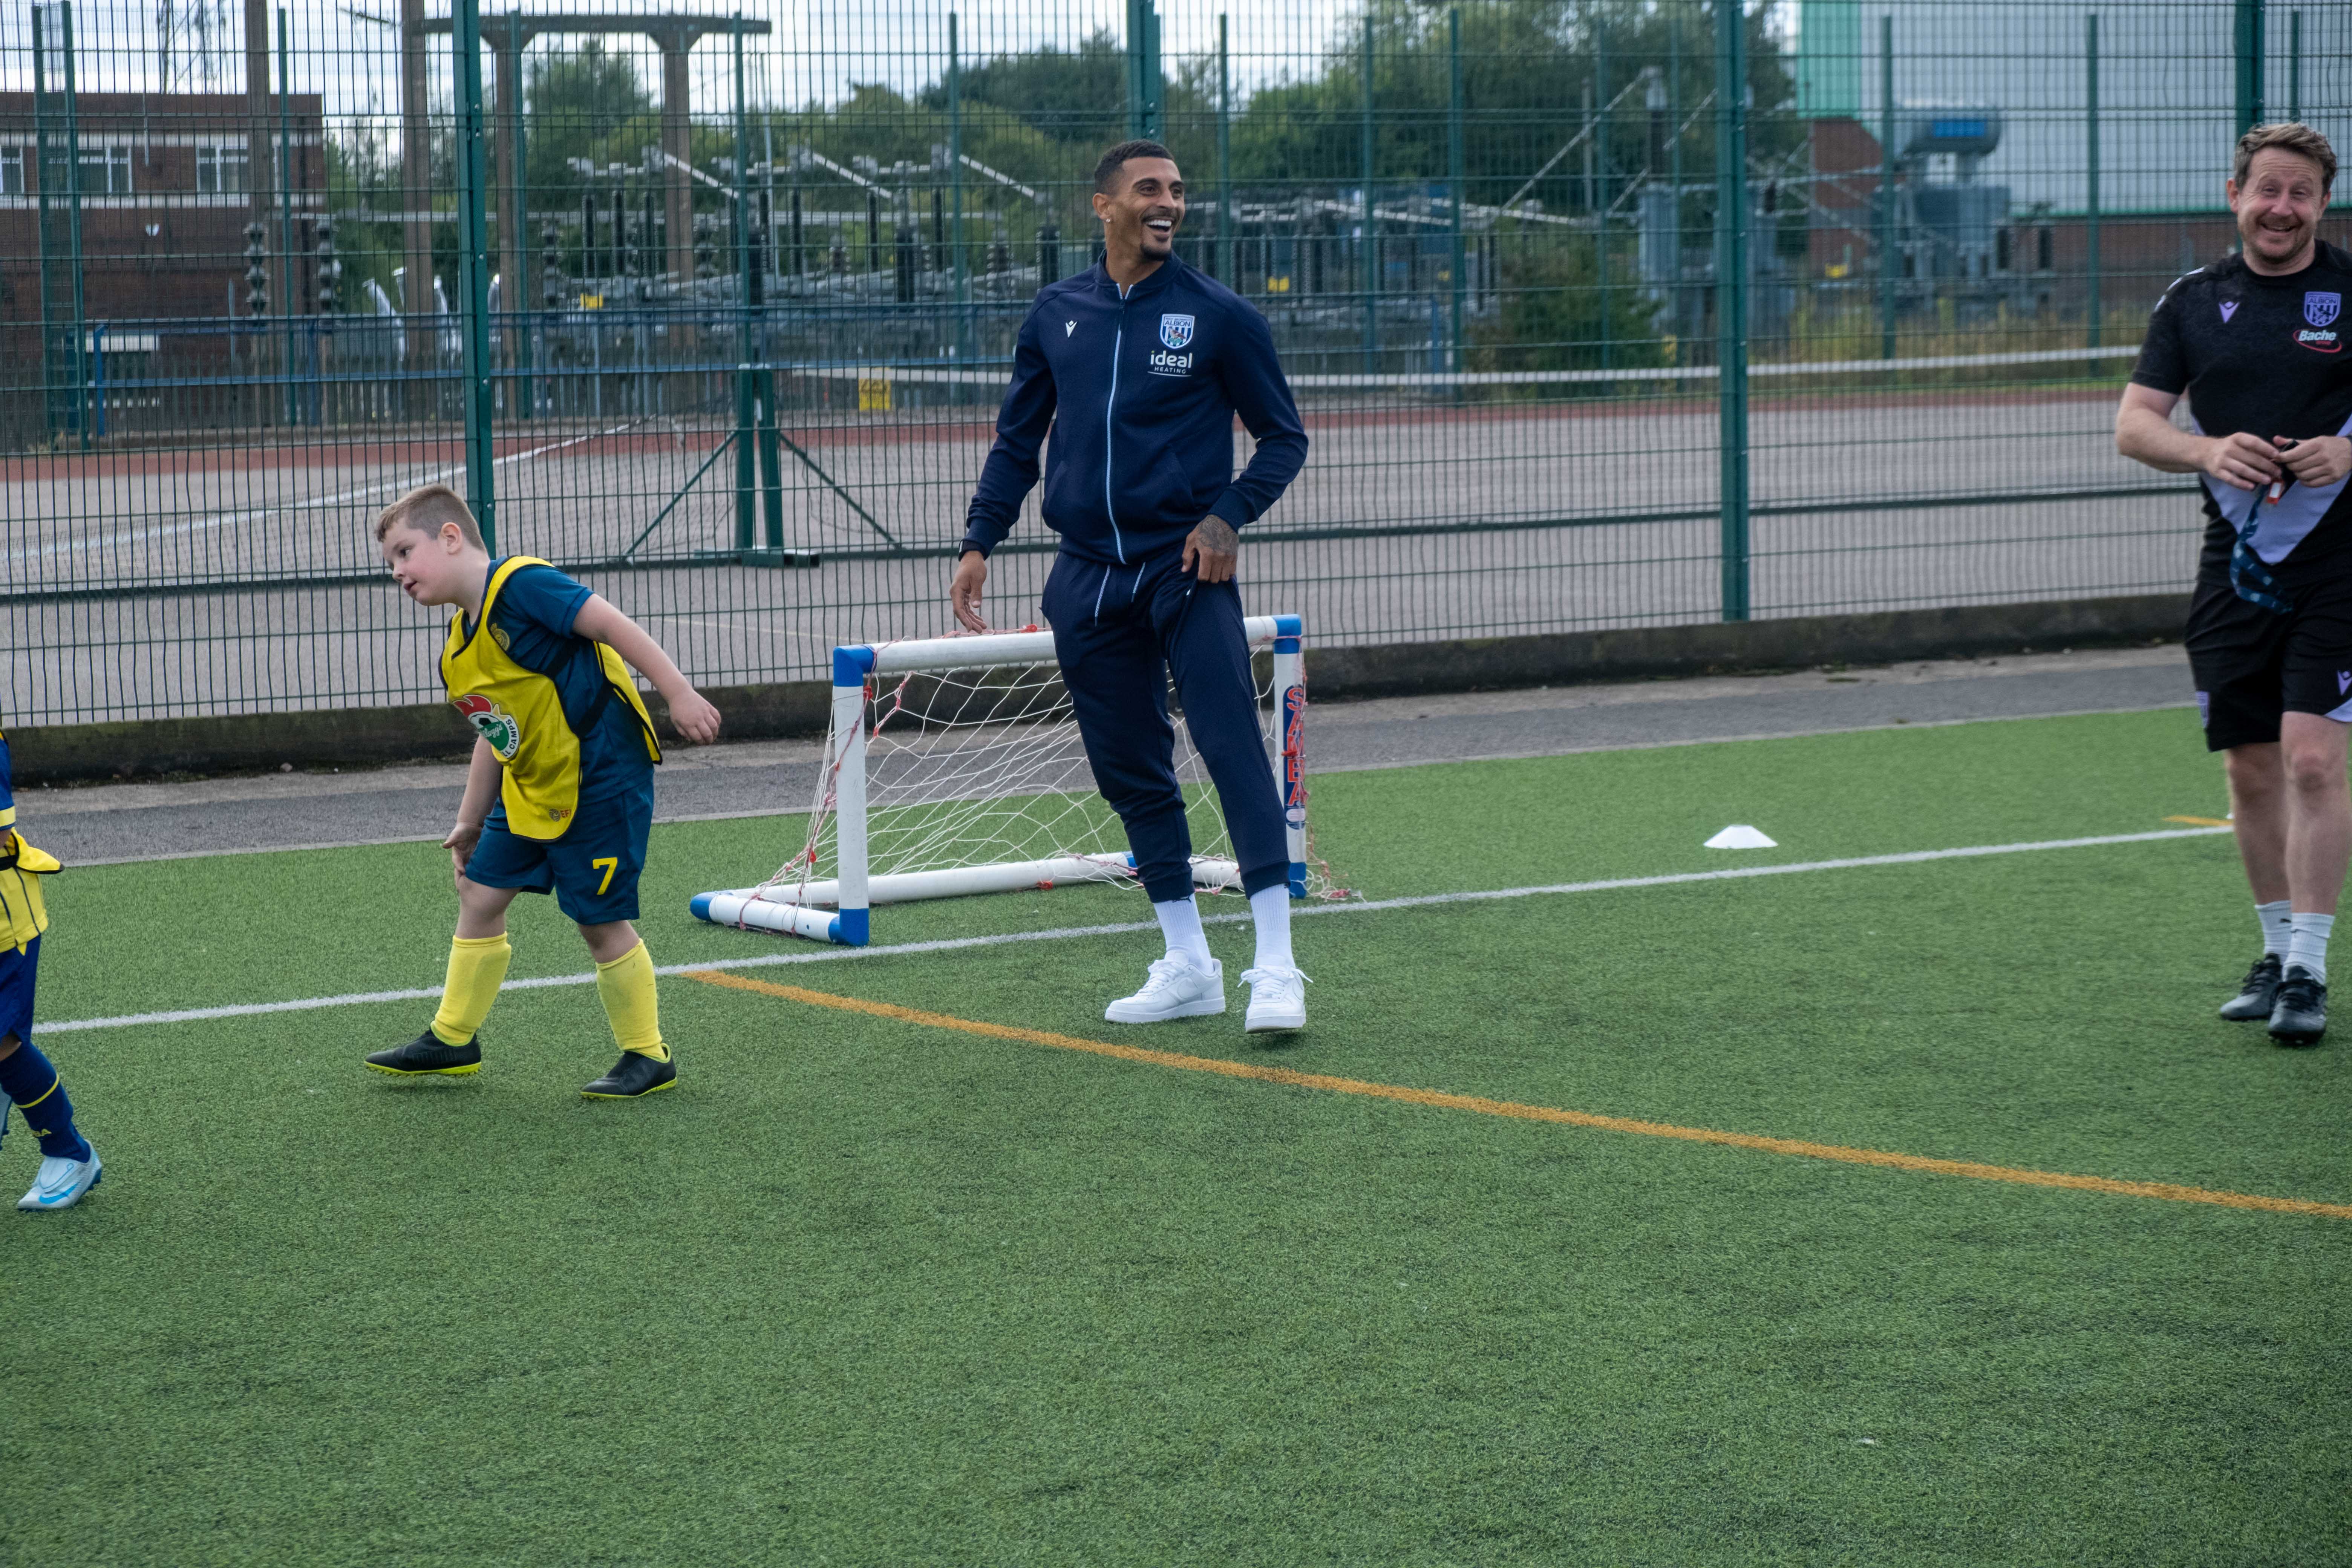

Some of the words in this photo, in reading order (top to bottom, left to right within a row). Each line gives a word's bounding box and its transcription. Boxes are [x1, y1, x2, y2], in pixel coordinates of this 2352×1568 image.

[2298, 330, 2337, 341] Bache
[1150, 350, 1192, 368] ideal
[506, 719, 517, 749] CAMPS
[1286, 687, 1305, 806] SAMBA
[593, 857, 618, 896] 7
